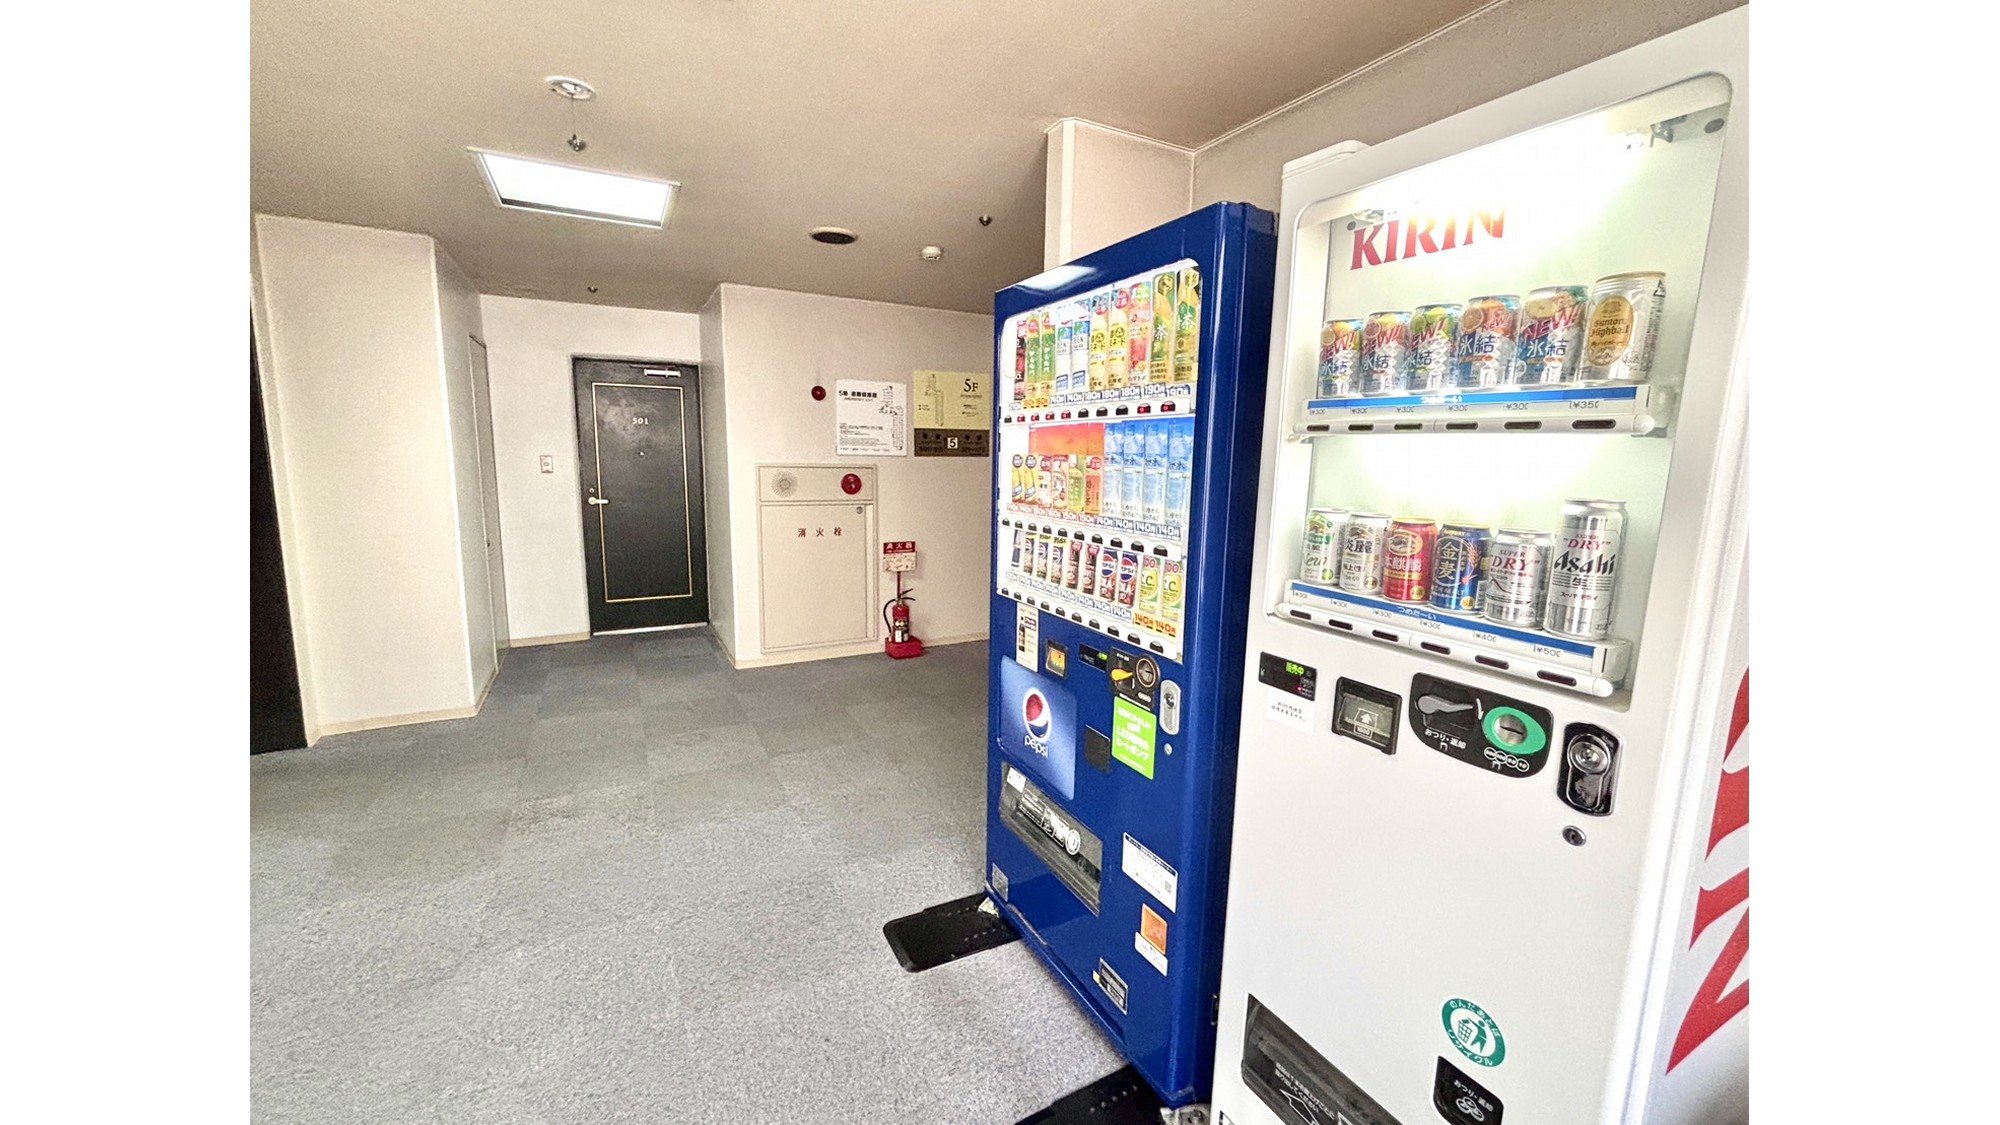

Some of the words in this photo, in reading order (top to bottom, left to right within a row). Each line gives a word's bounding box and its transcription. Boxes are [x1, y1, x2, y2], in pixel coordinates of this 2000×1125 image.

[1350, 207, 1505, 271] KIRIN
[1460, 334, 1496, 356] 氷結
[1527, 338, 1569, 358] 氷結
[963, 378, 979, 392] 5F
[632, 417, 649, 425] 501
[949, 438, 957, 448] 5
[798, 526, 842, 538] 消火栓
[1438, 541, 1460, 581] 金麦
[1553, 550, 1616, 575] Asahi
[1286, 662, 1305, 676] 販売中
[1024, 735, 1048, 759] pepsi
